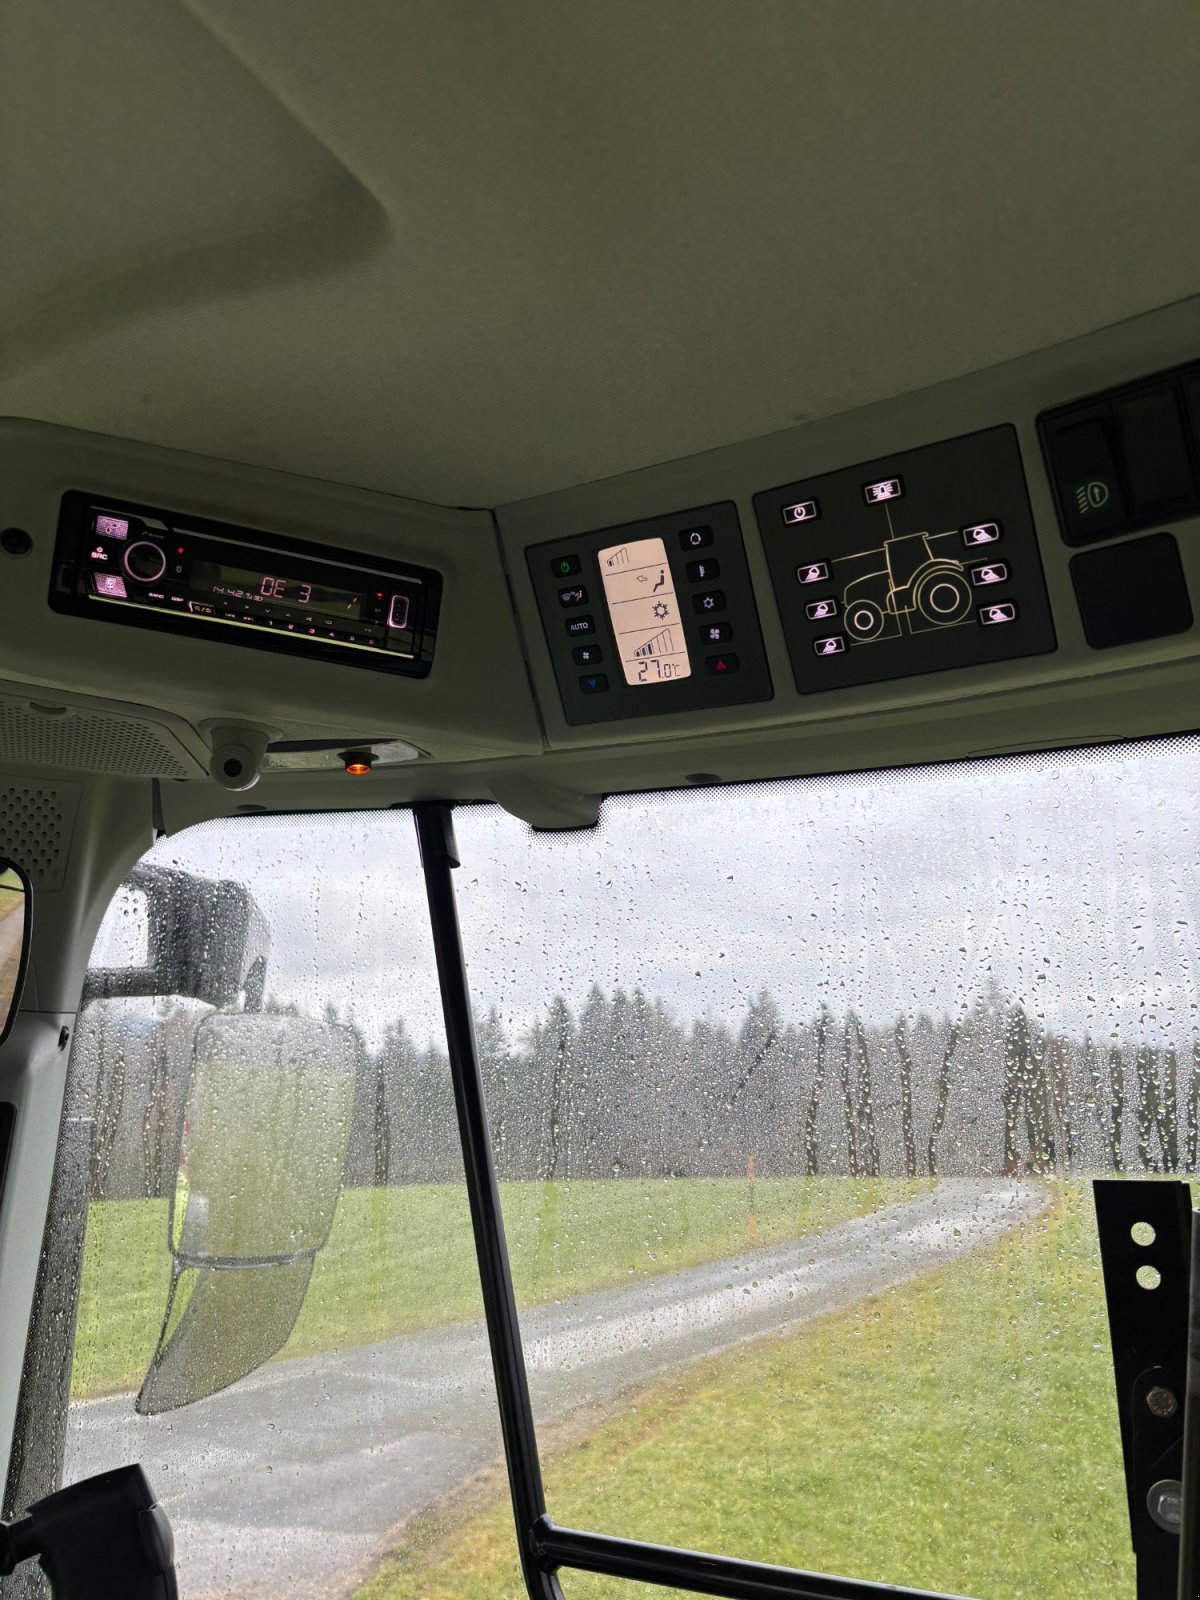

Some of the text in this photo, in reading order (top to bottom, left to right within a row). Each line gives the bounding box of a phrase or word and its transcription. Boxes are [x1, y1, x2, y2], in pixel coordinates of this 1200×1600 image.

[91, 551, 108, 560] SRC
[298, 584, 312, 603] 3
[570, 622, 589, 631] AUTO
